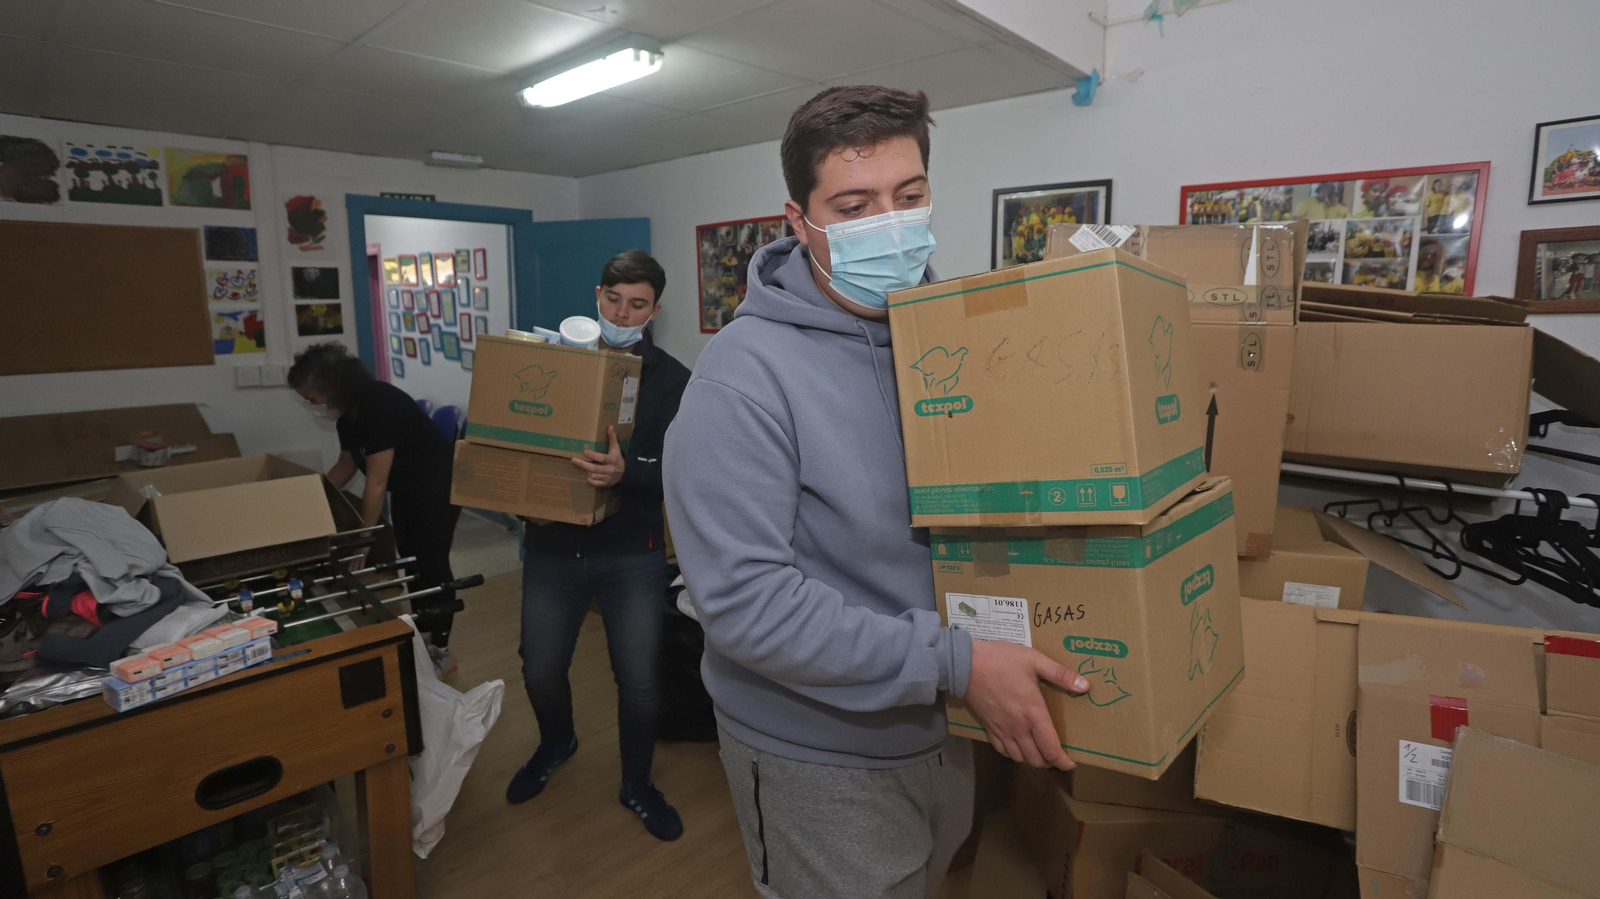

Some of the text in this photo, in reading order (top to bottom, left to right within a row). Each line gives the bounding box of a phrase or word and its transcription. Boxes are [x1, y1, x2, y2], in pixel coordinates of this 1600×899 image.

[1266, 244, 1275, 271] STL
[1210, 293, 1240, 301] STL
[1248, 339, 1257, 367] STL
[513, 400, 548, 416] texpol
[920, 397, 970, 416] texpol
[1184, 568, 1212, 596] texpol
[994, 599, 1024, 608] 1186.01
[1033, 602, 1086, 628] GASAS
[1070, 637, 1121, 656] texpol
